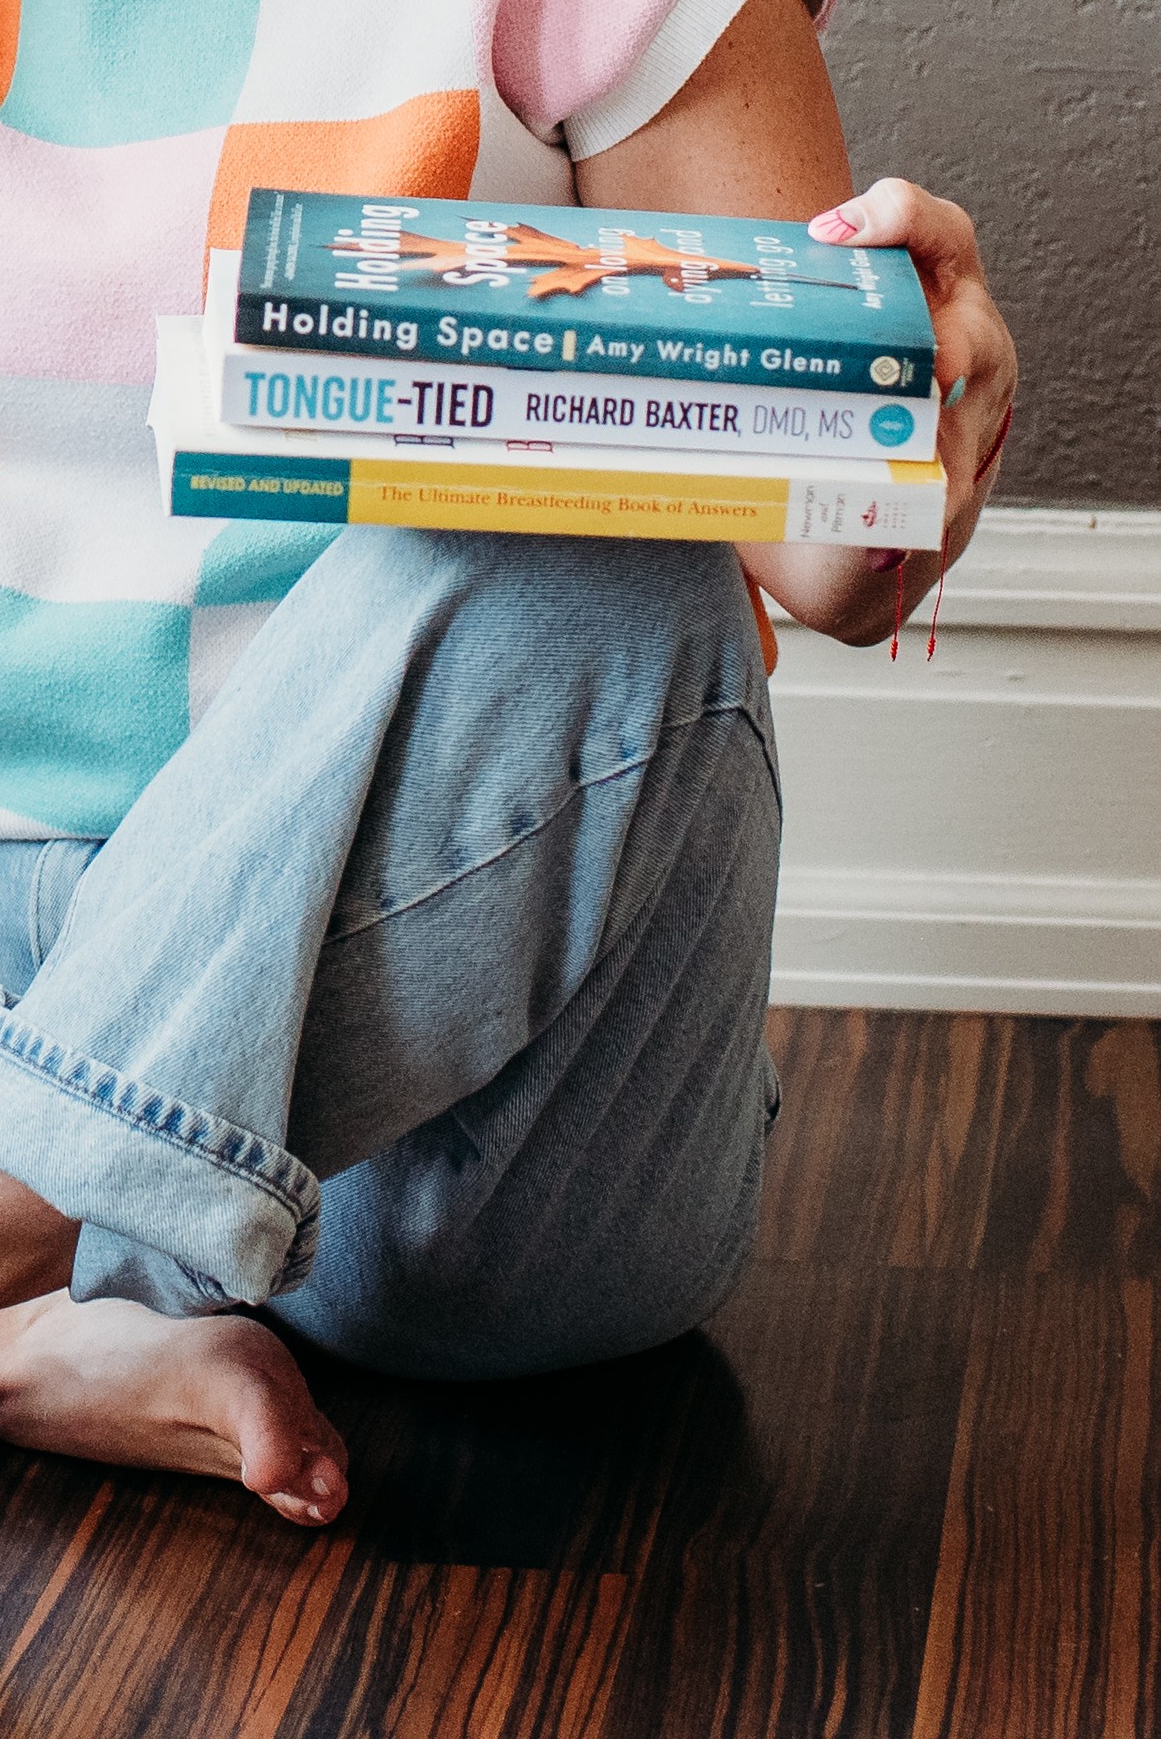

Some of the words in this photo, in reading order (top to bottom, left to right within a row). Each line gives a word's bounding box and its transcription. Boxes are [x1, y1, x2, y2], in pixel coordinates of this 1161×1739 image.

[333, 203, 420, 292] Holding
[442, 219, 528, 288] Space
[585, 226, 635, 272] loving
[660, 228, 703, 258] and
[753, 235, 793, 255] go
[601, 274, 630, 296] on
[668, 258, 722, 304] dying
[750, 258, 797, 309] letting
[262, 301, 419, 350] Holding
[438, 316, 554, 354] Space
[586, 335, 644, 363] Amy
[657, 339, 750, 370] Wright
[760, 348, 841, 375] Glenn
[244, 371, 495, 428] TONGUE-TIED
[525, 393, 634, 426] RICHARD
[645, 400, 742, 438] BAXTER,
[752, 405, 809, 441] DMD,
[819, 410, 854, 439] MS
[190, 474, 246, 492] REVISED
[247, 477, 280, 494] AND
[283, 479, 345, 497] UPDATED
[380, 486, 412, 502] The
[418, 488, 490, 506] Ultimate
[496, 491, 612, 515] Breastfeeding
[618, 497, 662, 513] Book
[666, 498, 684, 514] of
[688, 501, 758, 518] Answers
